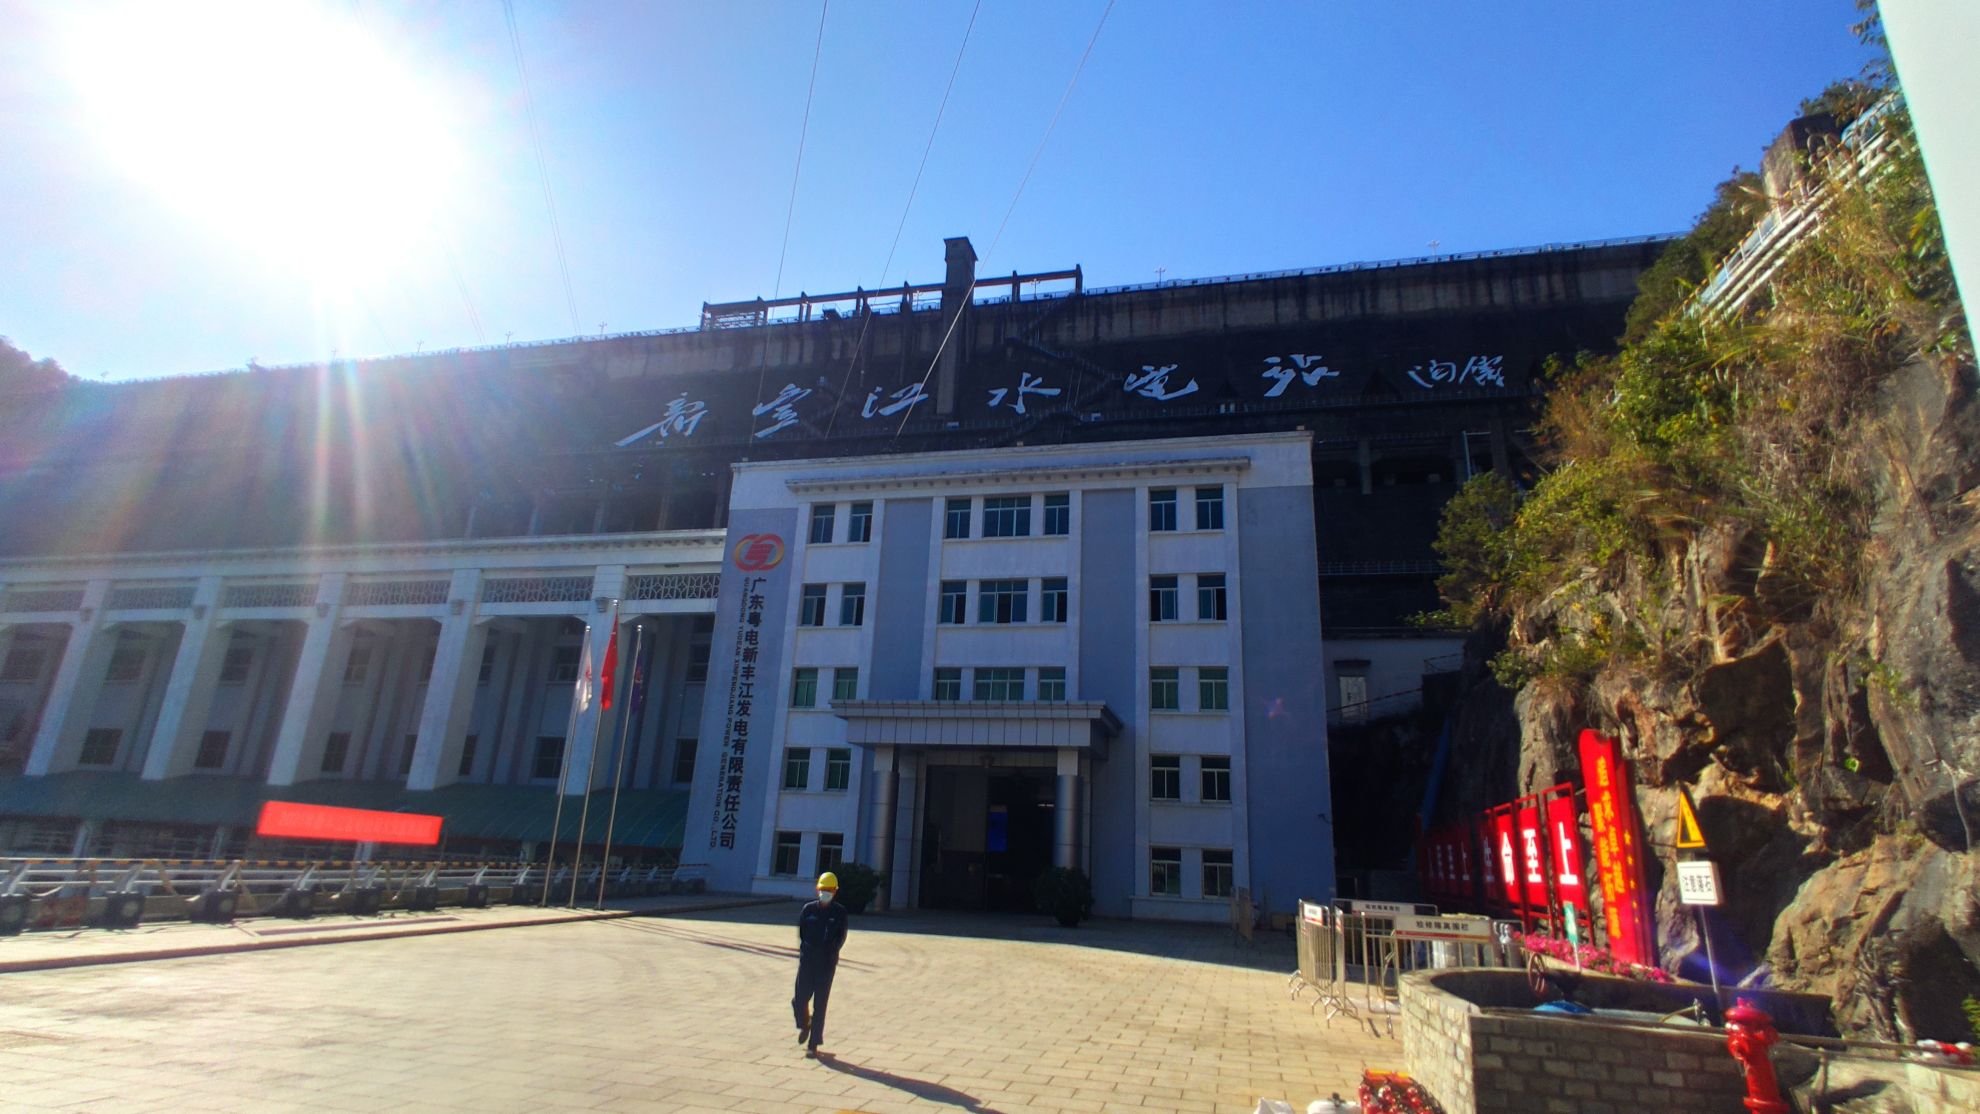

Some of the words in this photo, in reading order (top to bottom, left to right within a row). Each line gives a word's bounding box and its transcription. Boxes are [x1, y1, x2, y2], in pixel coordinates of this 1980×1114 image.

[739, 577, 750, 623] GUANGDONG
[735, 626, 744, 657] YUDEAN
[728, 658, 740, 715] XINFENGJIANG
[720, 576, 767, 850] 广东粤电新丰江发电有限责任公司
[723, 717, 732, 747] POWER
[715, 751, 728, 807] GENERATION
